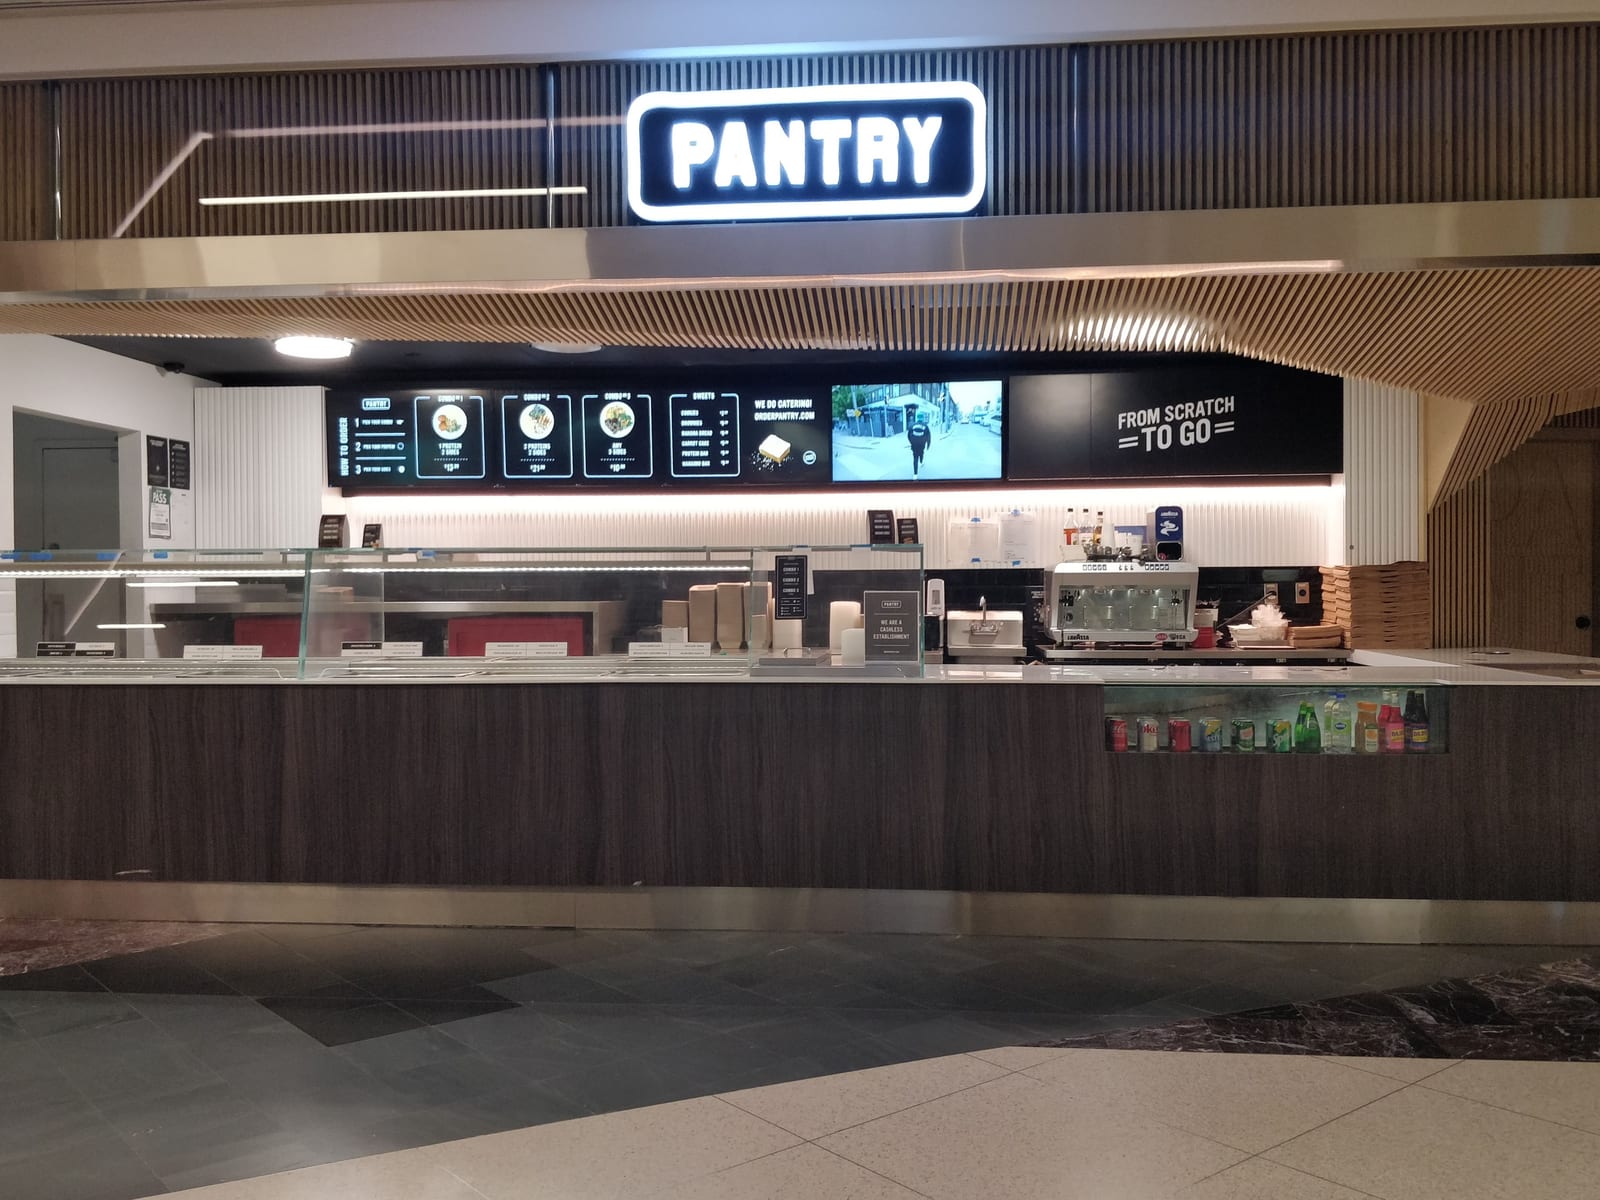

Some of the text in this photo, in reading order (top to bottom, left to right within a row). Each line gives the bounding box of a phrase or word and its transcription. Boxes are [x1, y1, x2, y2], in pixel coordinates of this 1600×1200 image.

[671, 115, 943, 189] PANTRY
[693, 392, 715, 400] SWEETS
[754, 399, 812, 409] WE DO CATERING!
[754, 411, 815, 421] ORDERPANTRY.COM
[1118, 396, 1235, 430] FROM SCRATCH
[355, 418, 359, 428] 1
[1141, 418, 1211, 452] TO GO
[339, 417, 349, 476] HOW TO ORDER
[355, 442, 361, 452] 2
[356, 465, 361, 475] 3
[152, 493, 167, 504] PASS
